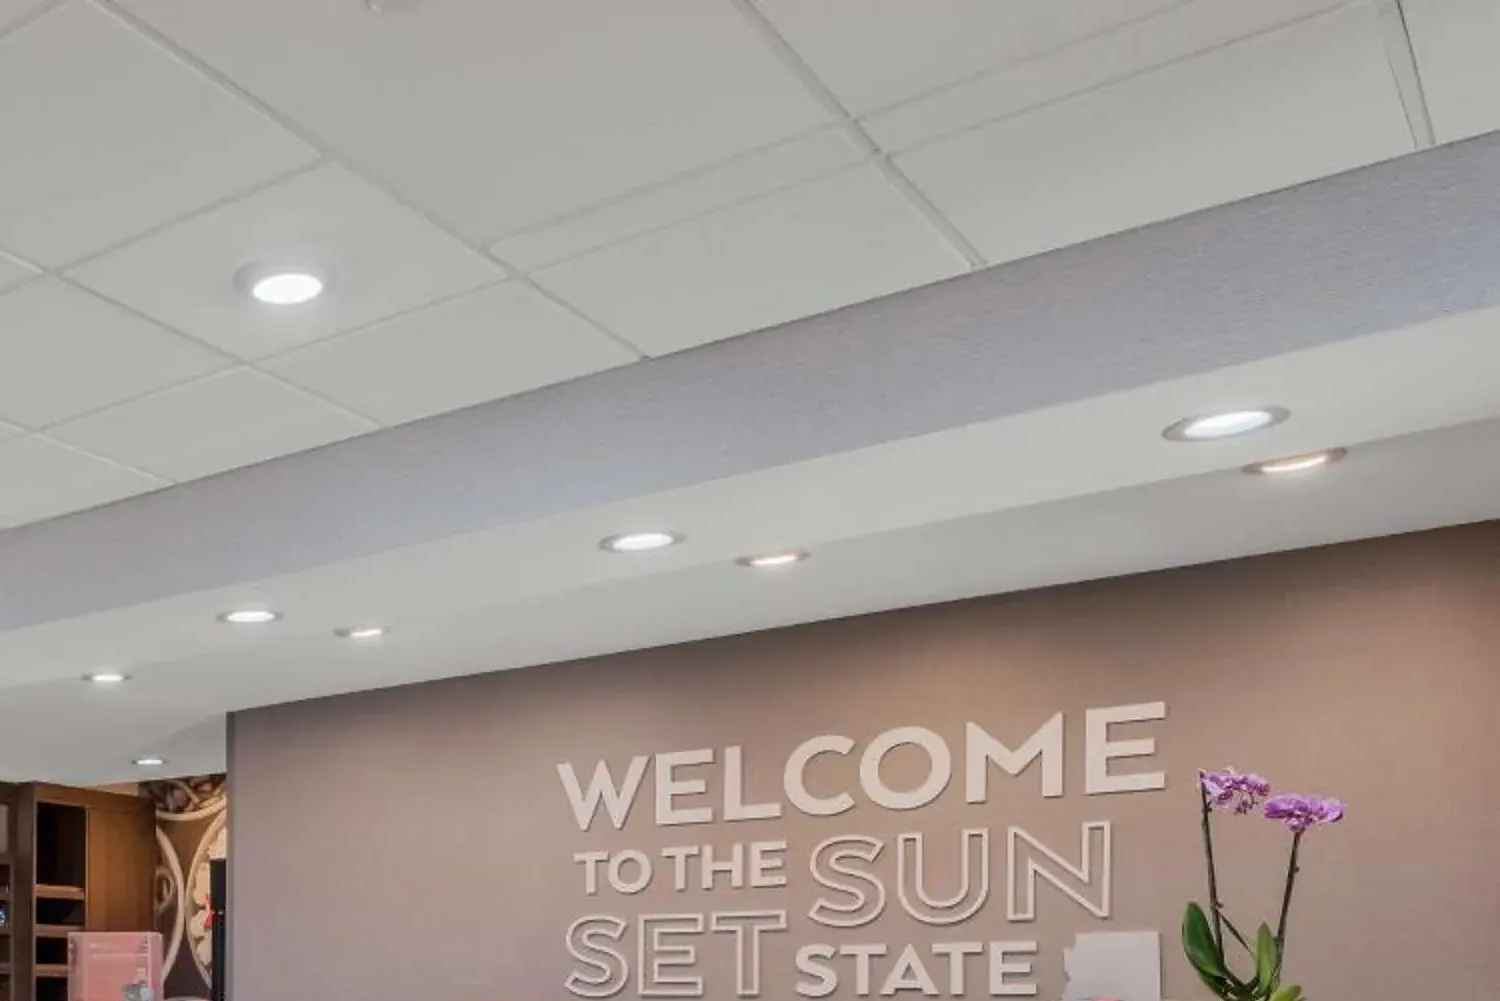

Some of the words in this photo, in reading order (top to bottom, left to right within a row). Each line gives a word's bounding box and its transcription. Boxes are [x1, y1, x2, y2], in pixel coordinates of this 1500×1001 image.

[556, 701, 1166, 831] WELCOME
[573, 849, 653, 895] TO
[660, 840, 788, 892] THE
[807, 820, 1111, 928] SUN
[564, 909, 788, 998] SET
[795, 941, 1037, 998] STATE
